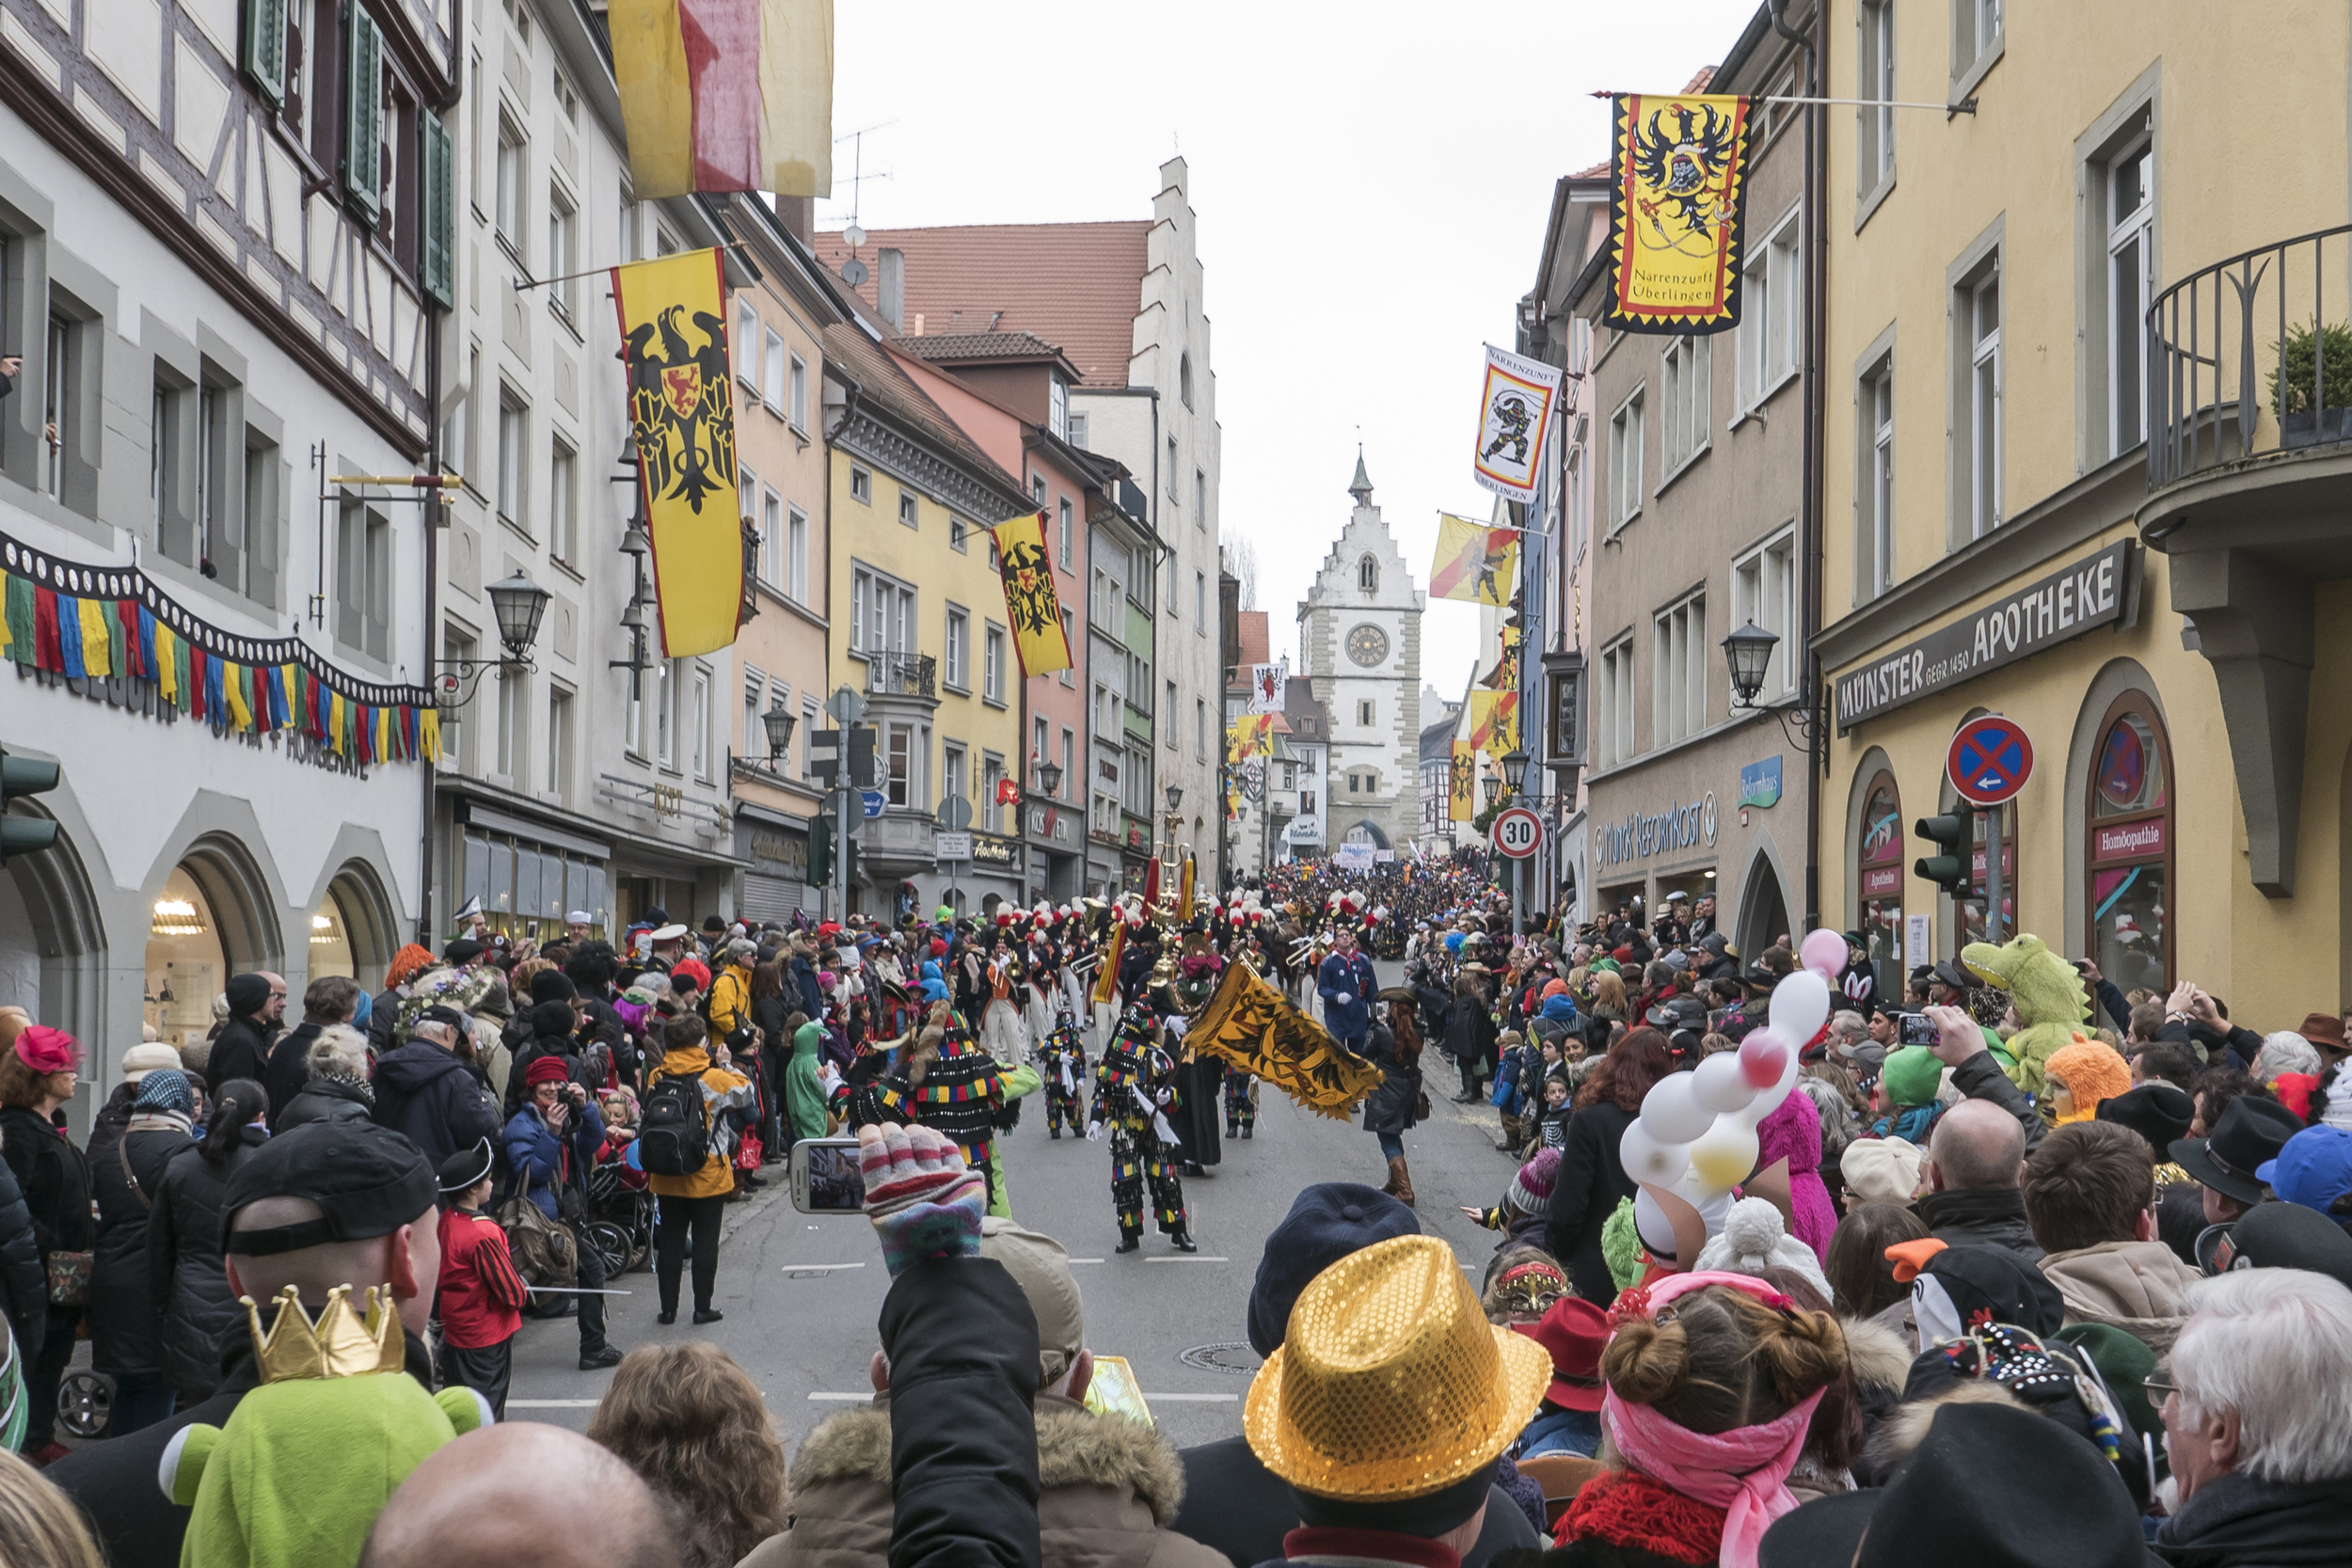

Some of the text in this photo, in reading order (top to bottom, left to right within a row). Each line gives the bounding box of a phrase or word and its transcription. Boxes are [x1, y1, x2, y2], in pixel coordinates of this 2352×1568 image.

[1634, 268, 1712, 285] Narrenzunft
[1632, 283, 1712, 302] Überlingen
[1488, 349, 1555, 383] NARRENZUNFT
[1476, 472, 1527, 500] ÜBERLINGEN
[1839, 648, 1925, 721] MÜNSTER
[1949, 649, 1969, 676] 1450
[1972, 554, 2114, 667] APOTHEKE
[1741, 771, 1778, 802] Reformhaus
[1506, 821, 1530, 844] 30
[2102, 825, 2159, 851] Homöopathie
[1871, 871, 1895, 890] Apotheke
